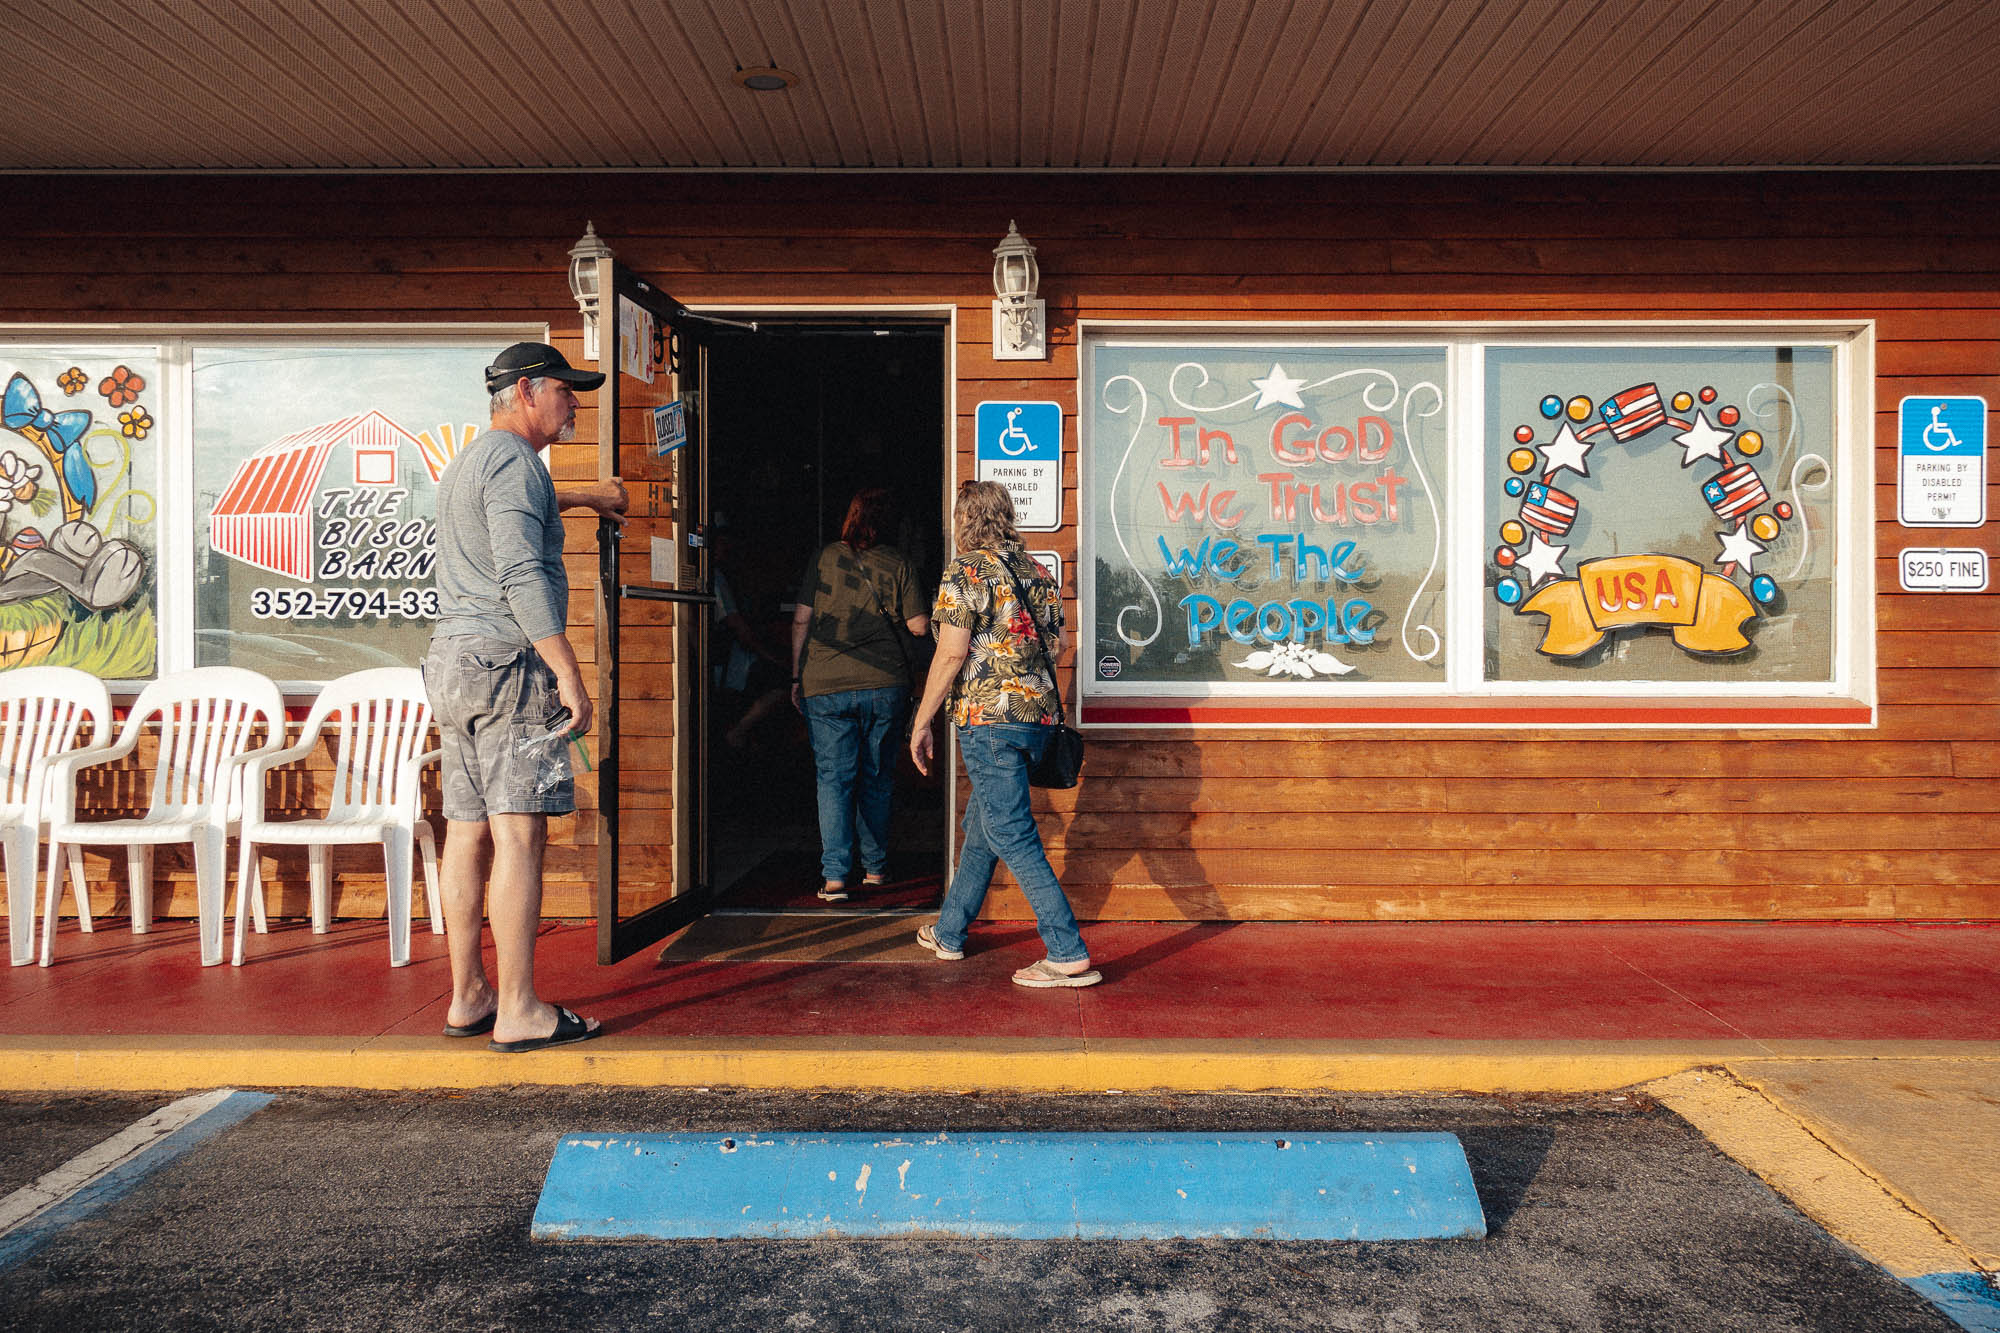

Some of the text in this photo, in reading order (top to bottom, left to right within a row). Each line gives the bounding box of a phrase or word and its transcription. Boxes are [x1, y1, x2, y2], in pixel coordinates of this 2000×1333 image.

[656, 411, 676, 440] CLOSED
[1157, 416, 1239, 467] In
[993, 468, 1044, 477] PARKING BY
[1916, 464, 1968, 473] PARKING BY
[1004, 482, 1038, 492] SABLED
[1922, 478, 1962, 487] DISABLED
[320, 488, 407, 517] THE
[1012, 497, 1033, 506] RMIT
[1156, 465, 1408, 530] We Trust
[1927, 492, 1957, 502] PERMIT
[1932, 507, 1952, 517] ONLY
[320, 549, 436, 578] BARN
[1156, 532, 1366, 583] We The
[1908, 561, 1980, 578] $250 FINE
[1596, 568, 1680, 613] USA
[253, 590, 439, 618] 352-794-33
